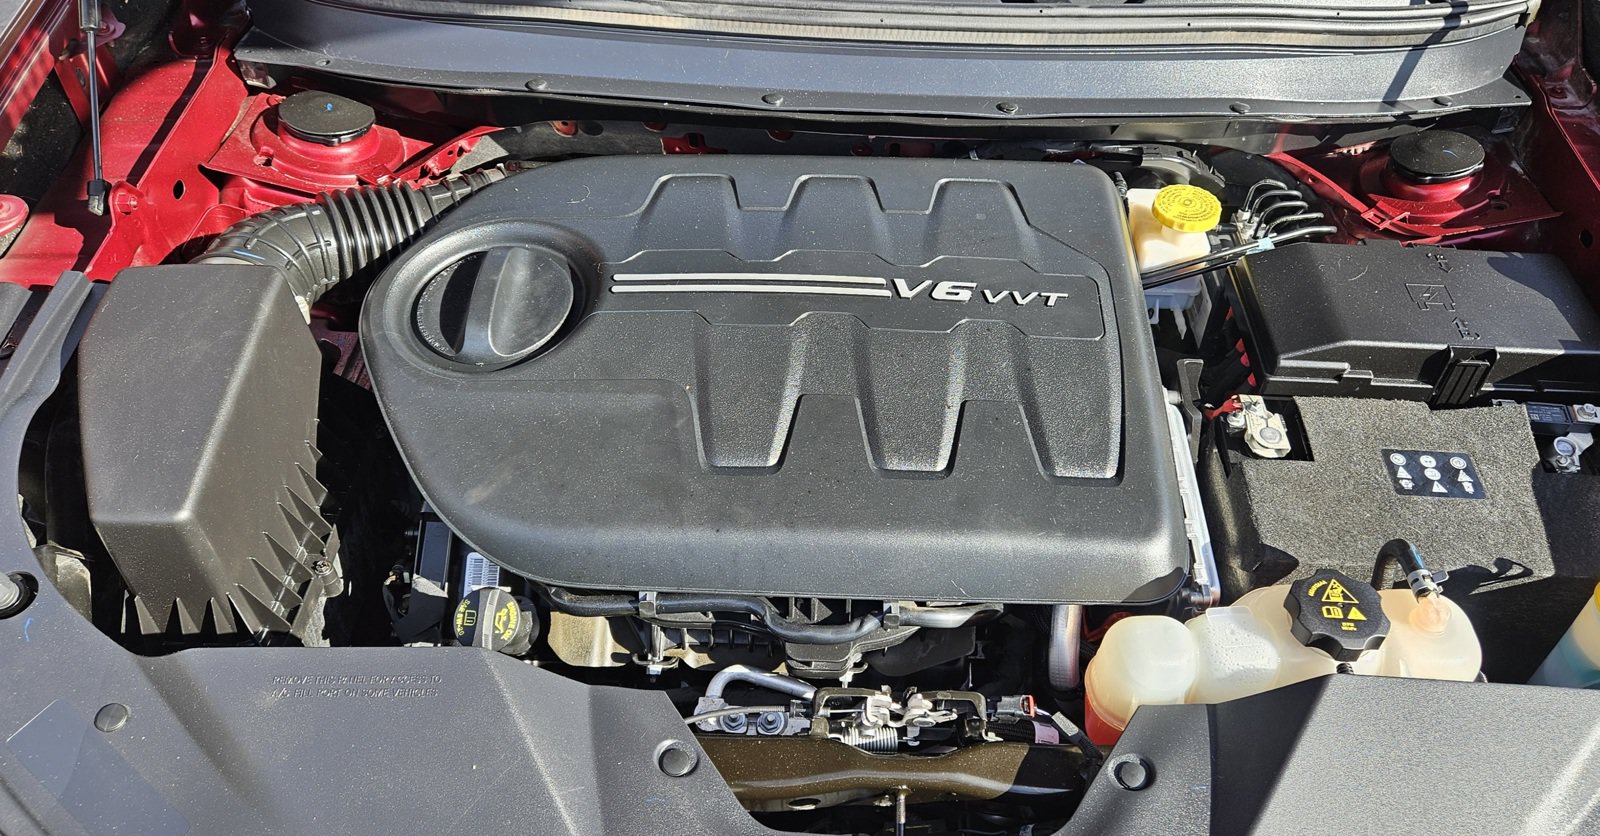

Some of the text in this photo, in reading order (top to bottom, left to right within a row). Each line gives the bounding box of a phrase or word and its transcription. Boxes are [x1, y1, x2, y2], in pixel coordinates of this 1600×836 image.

[891, 278, 1069, 307] V6 VVT
[500, 601, 517, 641] ENGINE OIL
[272, 674, 442, 685] REMOVE THIS PANEL FOR ACCESS TO
[271, 687, 438, 698] A/C FILL PORT ON SOME VEHICLES
